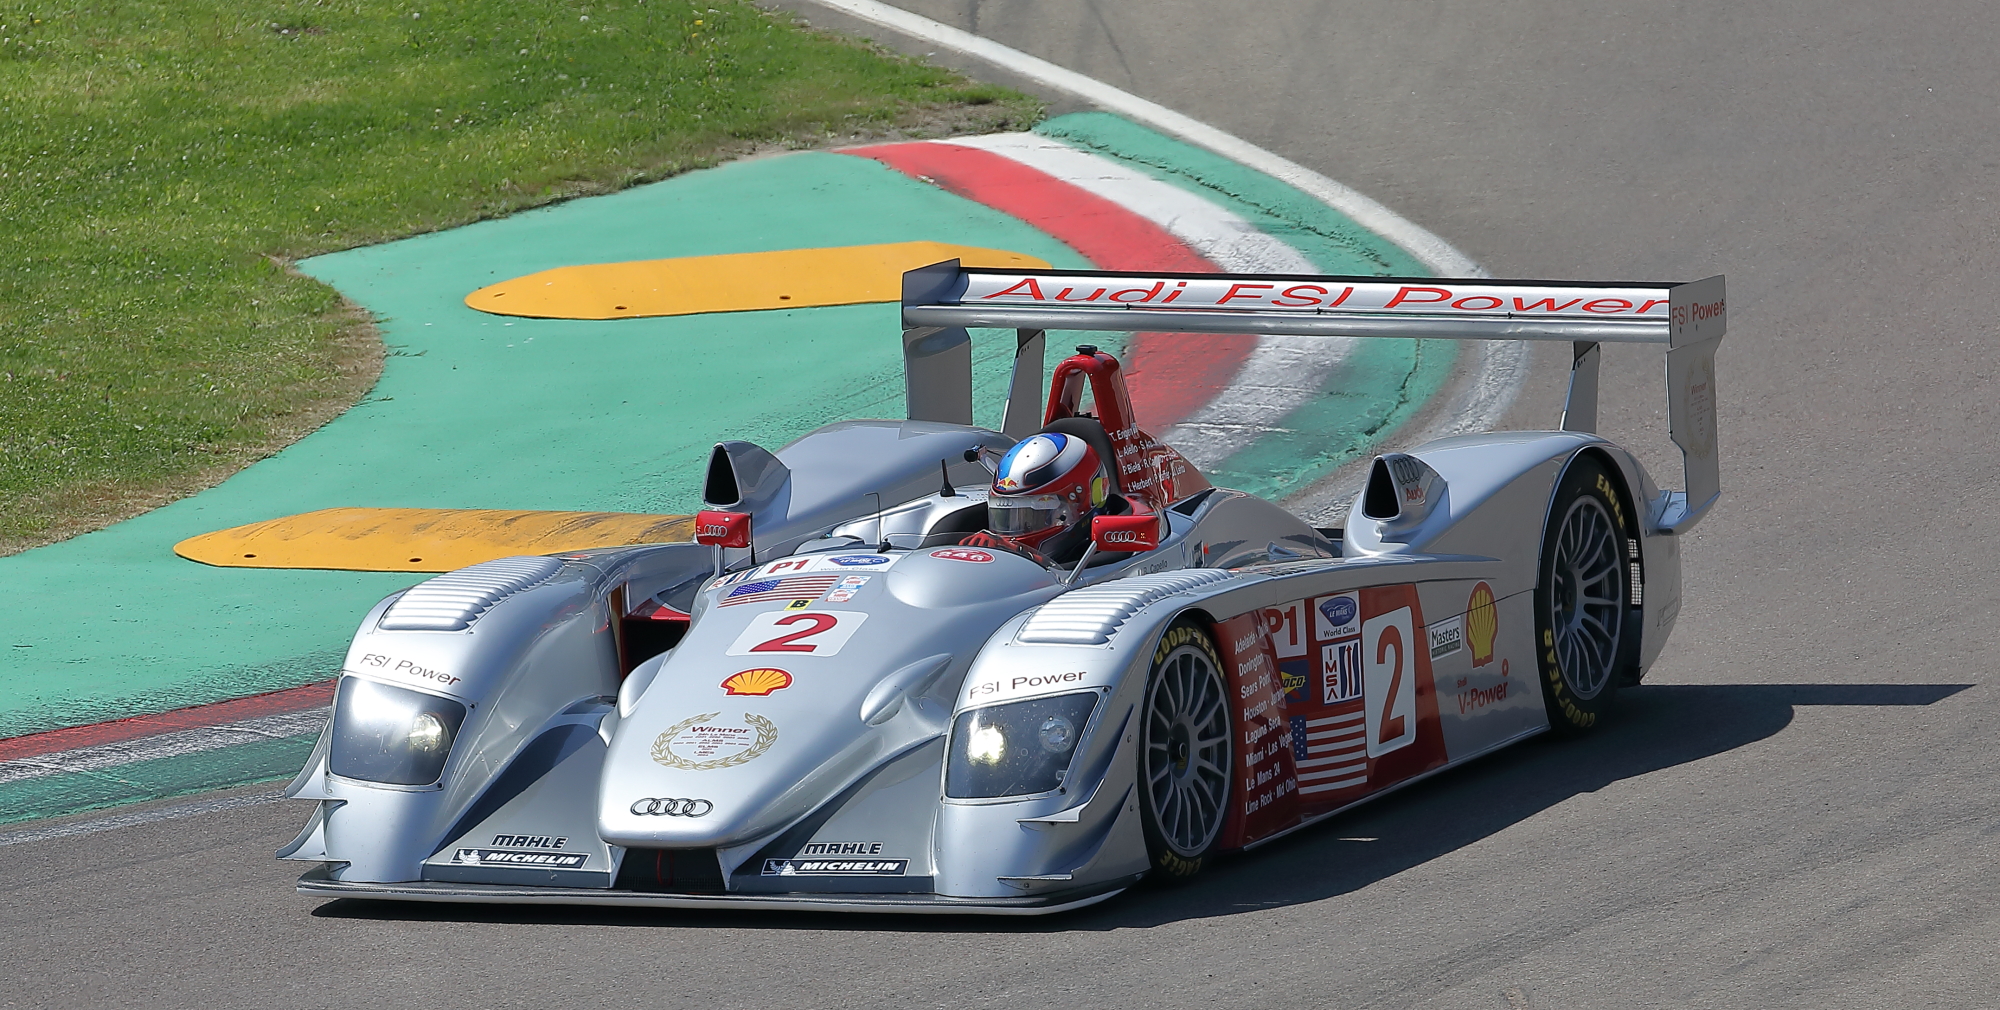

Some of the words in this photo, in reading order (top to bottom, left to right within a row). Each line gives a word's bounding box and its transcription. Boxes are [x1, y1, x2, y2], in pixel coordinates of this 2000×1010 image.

[982, 278, 1188, 303] Audi
[1215, 283, 1354, 308] FSI
[1383, 286, 1670, 314] Power
[1671, 305, 1689, 328] FSI
[1692, 301, 1724, 322] Power
[1406, 484, 1424, 501] Audi
[1597, 473, 1625, 529] EAGLE
[767, 559, 810, 574] P1
[790, 599, 809, 608] B
[748, 613, 838, 653] 2
[1234, 631, 1256, 655] Adelaide
[1323, 627, 1341, 638] World
[1342, 625, 1356, 634] Class
[1431, 626, 1460, 647] Masters
[1154, 626, 1224, 678] GOODYEAR
[1238, 652, 1264, 677] Donington
[360, 653, 391, 668] FSI
[394, 660, 462, 685] Power
[1325, 648, 1339, 701] IMSA
[1543, 628, 1595, 727] GOODYEAR
[970, 681, 1000, 699] FSI
[1012, 671, 1087, 689] Power
[1240, 681, 1258, 699] Sears
[1258, 670, 1272, 689] Point
[1376, 625, 1405, 744] 2
[1458, 682, 1508, 714] V-Power
[1243, 699, 1268, 722] Houston
[692, 726, 751, 734] Winner
[1245, 724, 1268, 744] Laguna
[1268, 715, 1281, 732] Seca
[1246, 747, 1264, 768] Miami
[1268, 740, 1278, 754] Las
[1279, 729, 1293, 749] Vegas
[1246, 776, 1256, 791] Le
[1257, 768, 1272, 786] Mans
[1273, 762, 1281, 776] 24
[1245, 799, 1259, 815] Lime
[1260, 792, 1272, 808] Rock
[1276, 783, 1285, 797] Mid
[1285, 778, 1296, 792] Ohio
[490, 834, 568, 849] MAHLE
[803, 842, 883, 855] MAHLE
[485, 852, 581, 865] MICHELIN
[800, 861, 900, 871] MICHELIN
[1160, 849, 1202, 876] EAGLE
